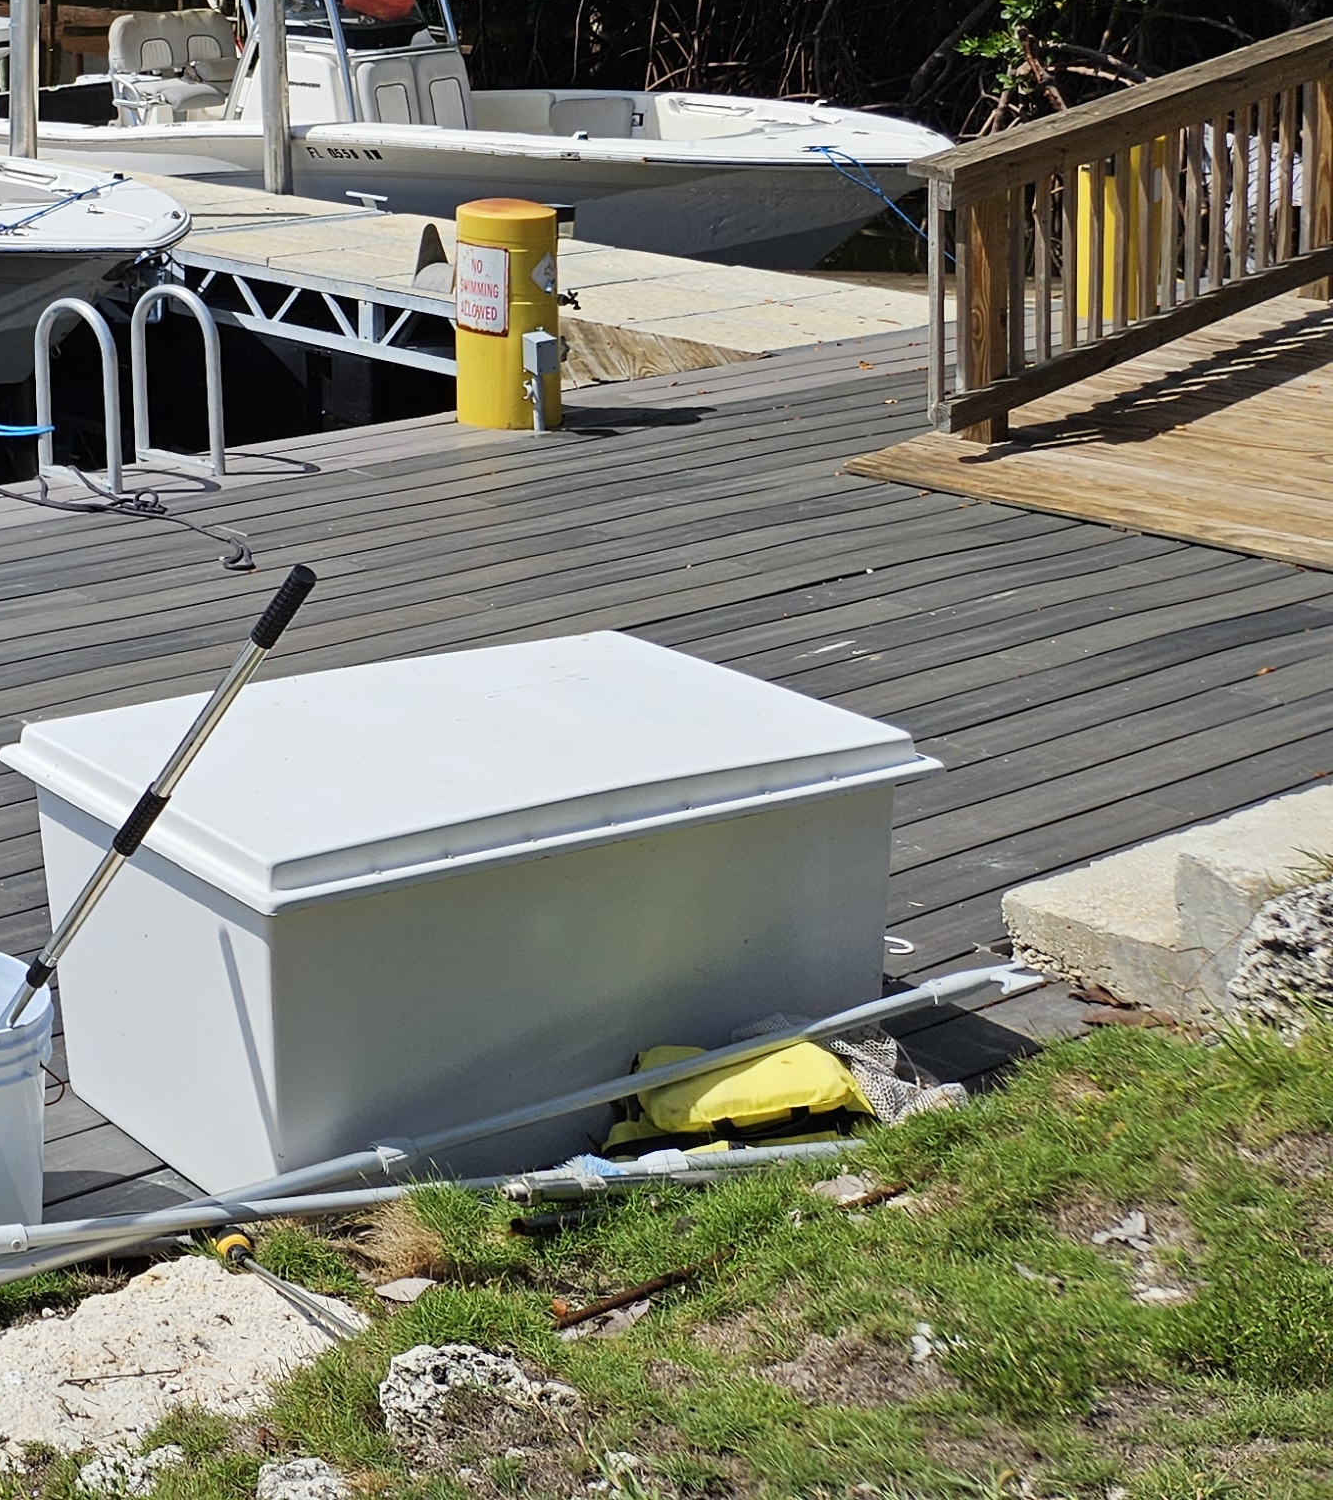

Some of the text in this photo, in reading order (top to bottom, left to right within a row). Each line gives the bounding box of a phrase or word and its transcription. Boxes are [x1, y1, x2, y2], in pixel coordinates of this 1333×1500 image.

[306, 146, 324, 159] FL
[471, 258, 483, 274] NO
[460, 278, 499, 299] SWIMMING
[460, 299, 498, 321] ALLOWED
